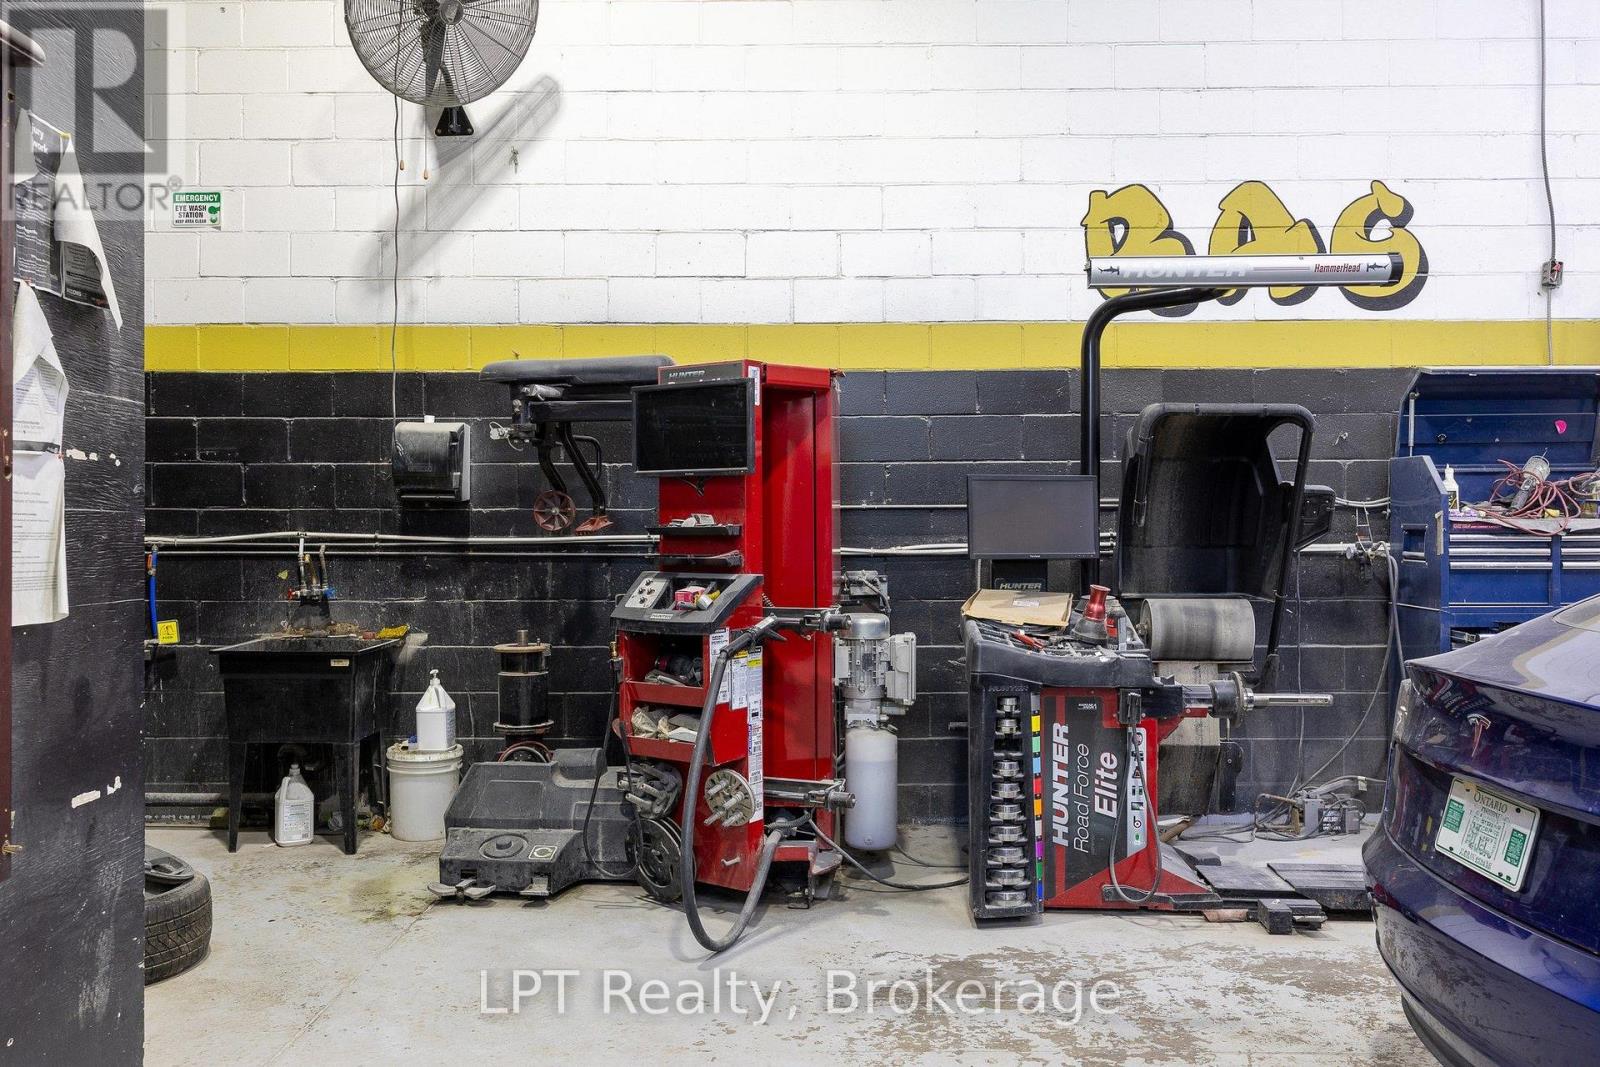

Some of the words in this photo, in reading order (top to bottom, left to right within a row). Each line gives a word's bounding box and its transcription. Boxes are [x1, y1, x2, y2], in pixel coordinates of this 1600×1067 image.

[175, 194, 218, 202] EMERGENCY
[1314, 263, 1361, 273] HammerHead
[1052, 722, 1069, 847] HUNTER
[1073, 743, 1089, 799] Force
[1094, 751, 1118, 818] Elite
[1073, 801, 1089, 853] Road
[1474, 791, 1508, 813] ONTARIO
